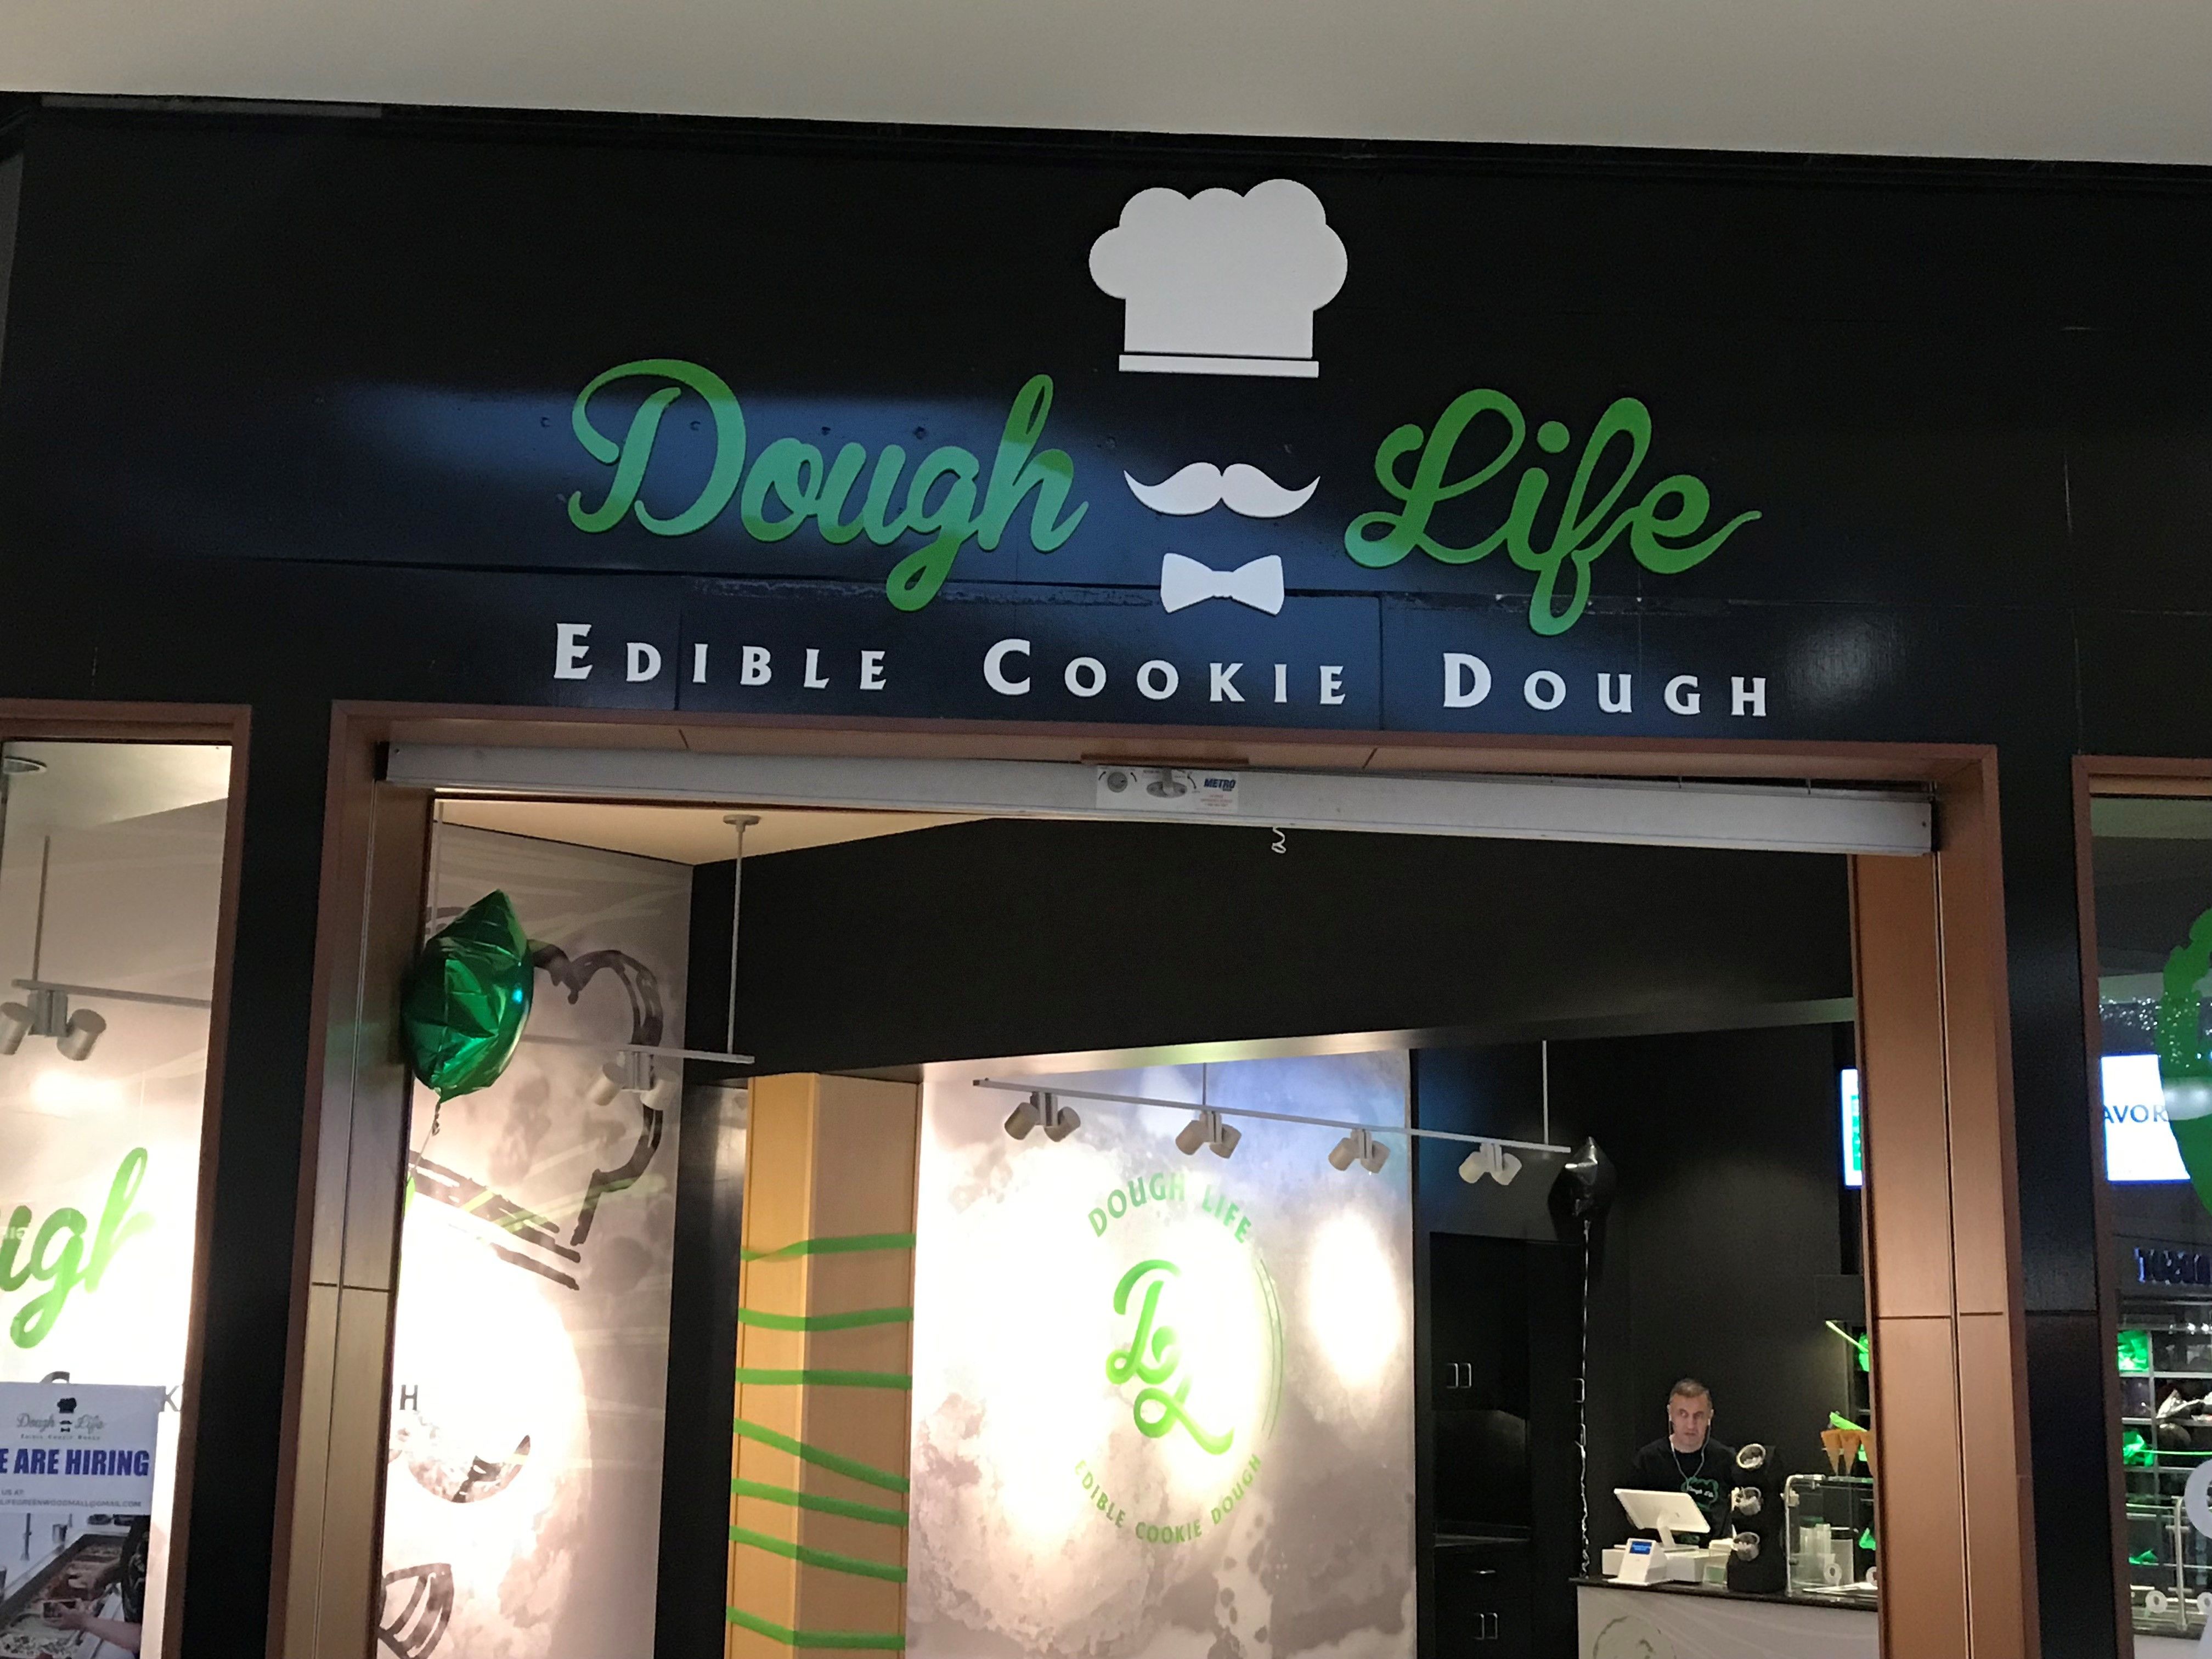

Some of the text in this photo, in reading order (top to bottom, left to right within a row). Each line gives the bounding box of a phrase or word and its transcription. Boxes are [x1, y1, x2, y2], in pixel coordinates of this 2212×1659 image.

[567, 358, 1762, 636] Dough Life
[554, 623, 1767, 717] EDIBLE COOKIE DOUGH
[1204, 777, 1236, 789] METRO
[1088, 1172, 1252, 1244] DOUGH LIFE
[13, 1448, 59, 1474] ARE
[65, 1449, 150, 1476] HIRING
[1075, 1453, 1262, 1545] EDIBLE COOKIE DOUGH
